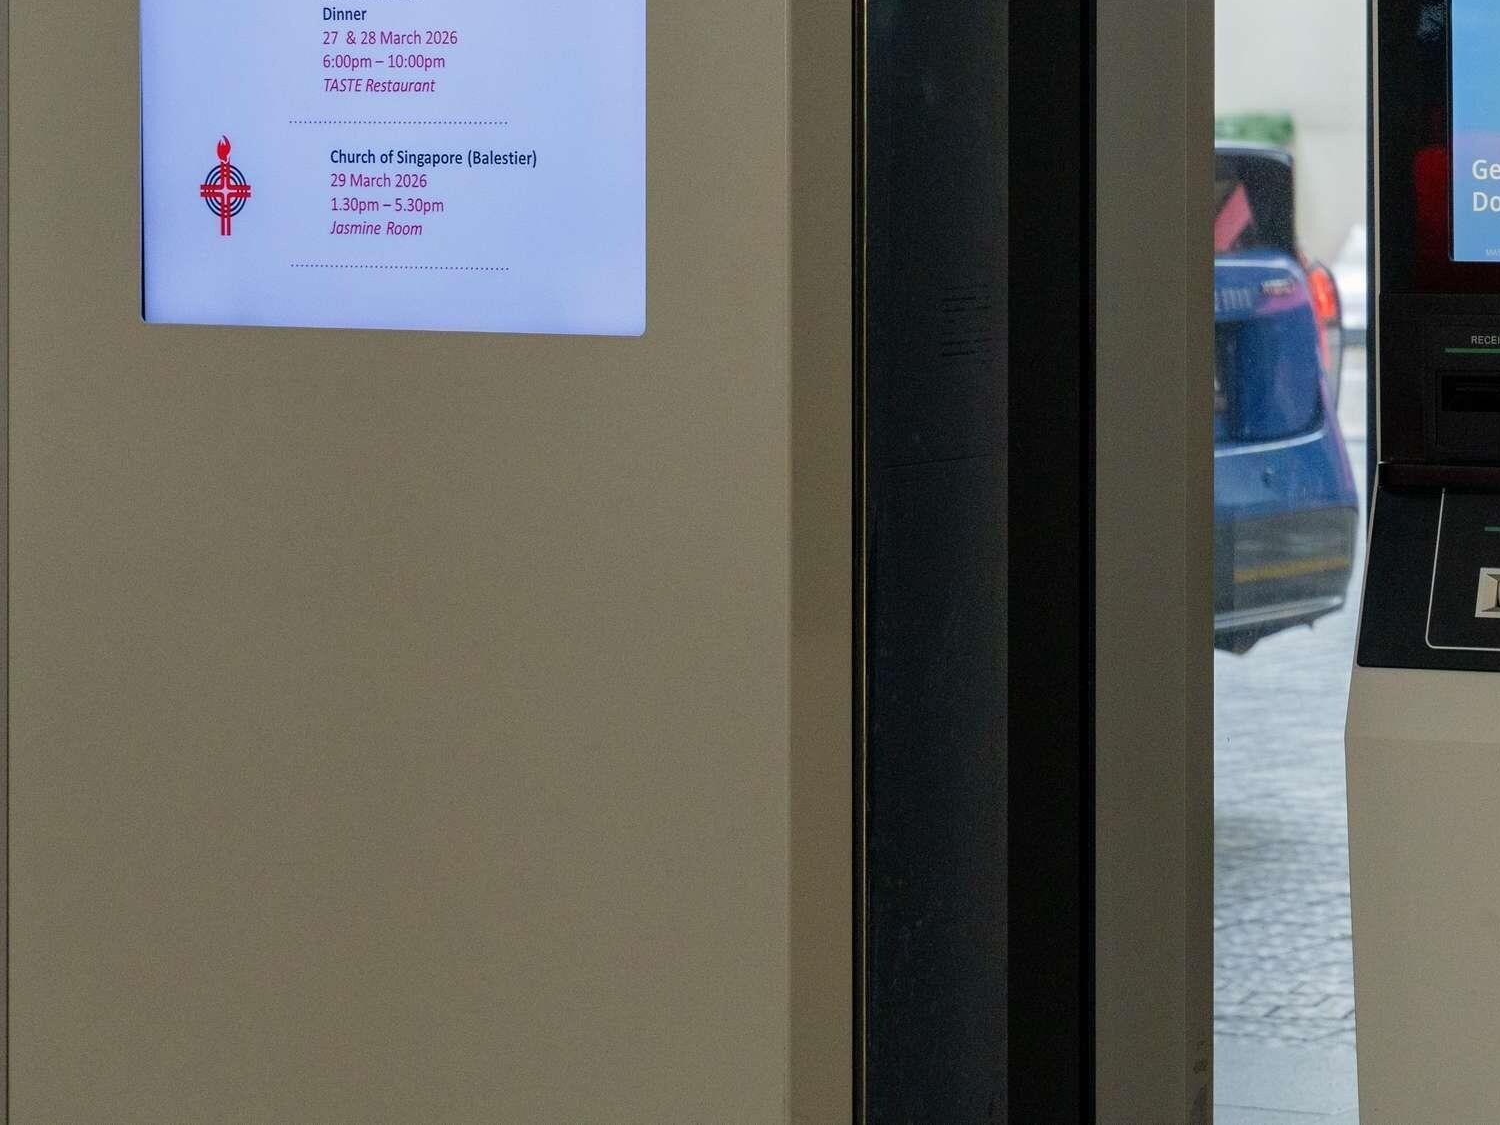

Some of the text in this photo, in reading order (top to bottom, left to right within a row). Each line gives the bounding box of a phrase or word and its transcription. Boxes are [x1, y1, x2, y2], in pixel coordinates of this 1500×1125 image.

[322, 7, 367, 21] Dinner
[323, 30, 457, 45] 27 & 28 March 2026
[323, 54, 372, 71] 6:00pm
[388, 54, 445, 71] 10:00pm
[323, 78, 436, 92] TASTE Restaurant
[330, 149, 537, 168] Church of Singapore (Balestier)
[330, 173, 427, 188] 29 March 2026
[331, 197, 379, 214] 1.30pm
[395, 198, 444, 214] 5.30pm
[330, 221, 422, 236] Jasmine Room
